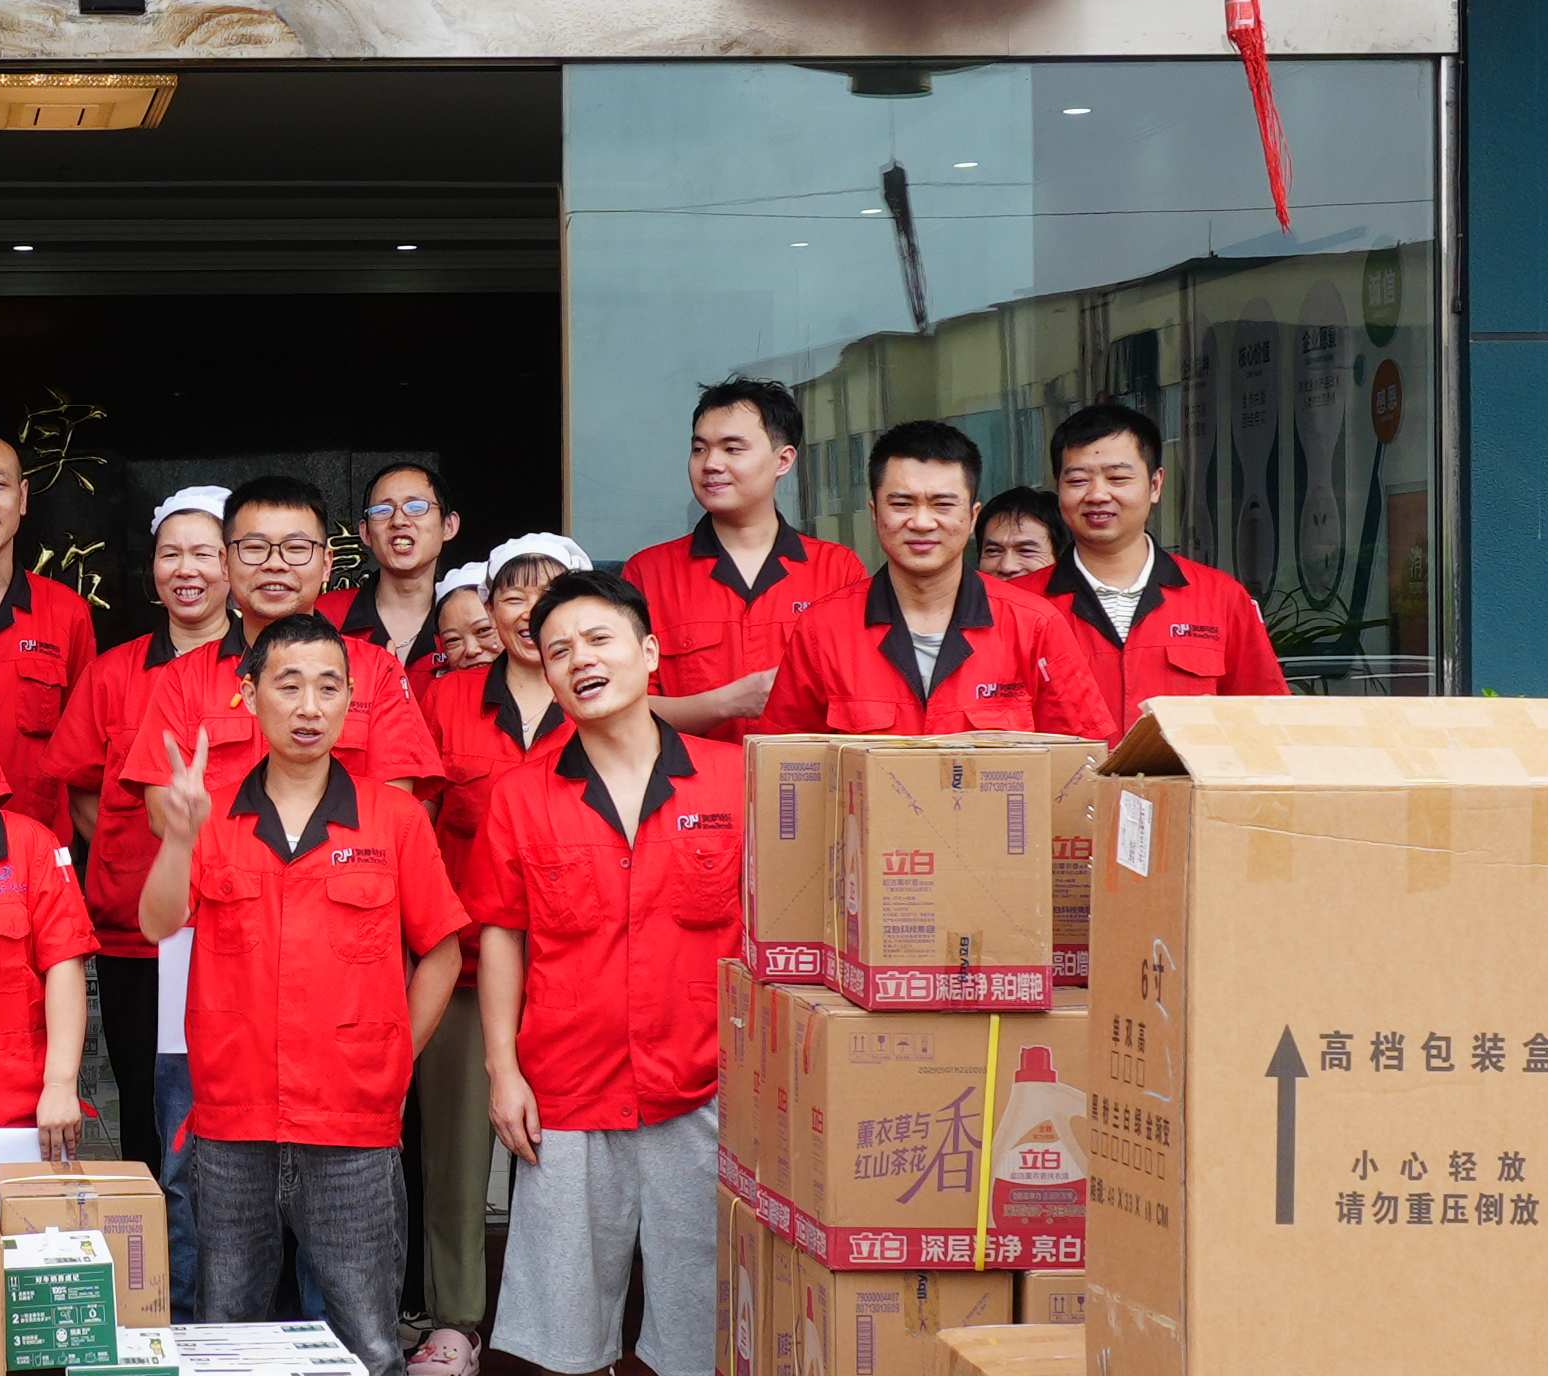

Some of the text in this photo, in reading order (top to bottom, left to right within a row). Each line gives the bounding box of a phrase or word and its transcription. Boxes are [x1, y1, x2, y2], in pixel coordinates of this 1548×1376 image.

[882, 849, 935, 876] 立白
[766, 946, 821, 975] 立白
[875, 971, 1044, 1003] 立白 深层洁净 亮白增艳
[856, 1111, 930, 1150] 薰衣草与
[896, 1086, 983, 1205] 香
[854, 1145, 927, 1180] 红山茶花
[1019, 1149, 1062, 1170] 立白
[1351, 1149, 1526, 1184] 小心轻放
[1334, 1190, 1540, 1227] 请勿重压倒放
[849, 1232, 907, 1263] 立白
